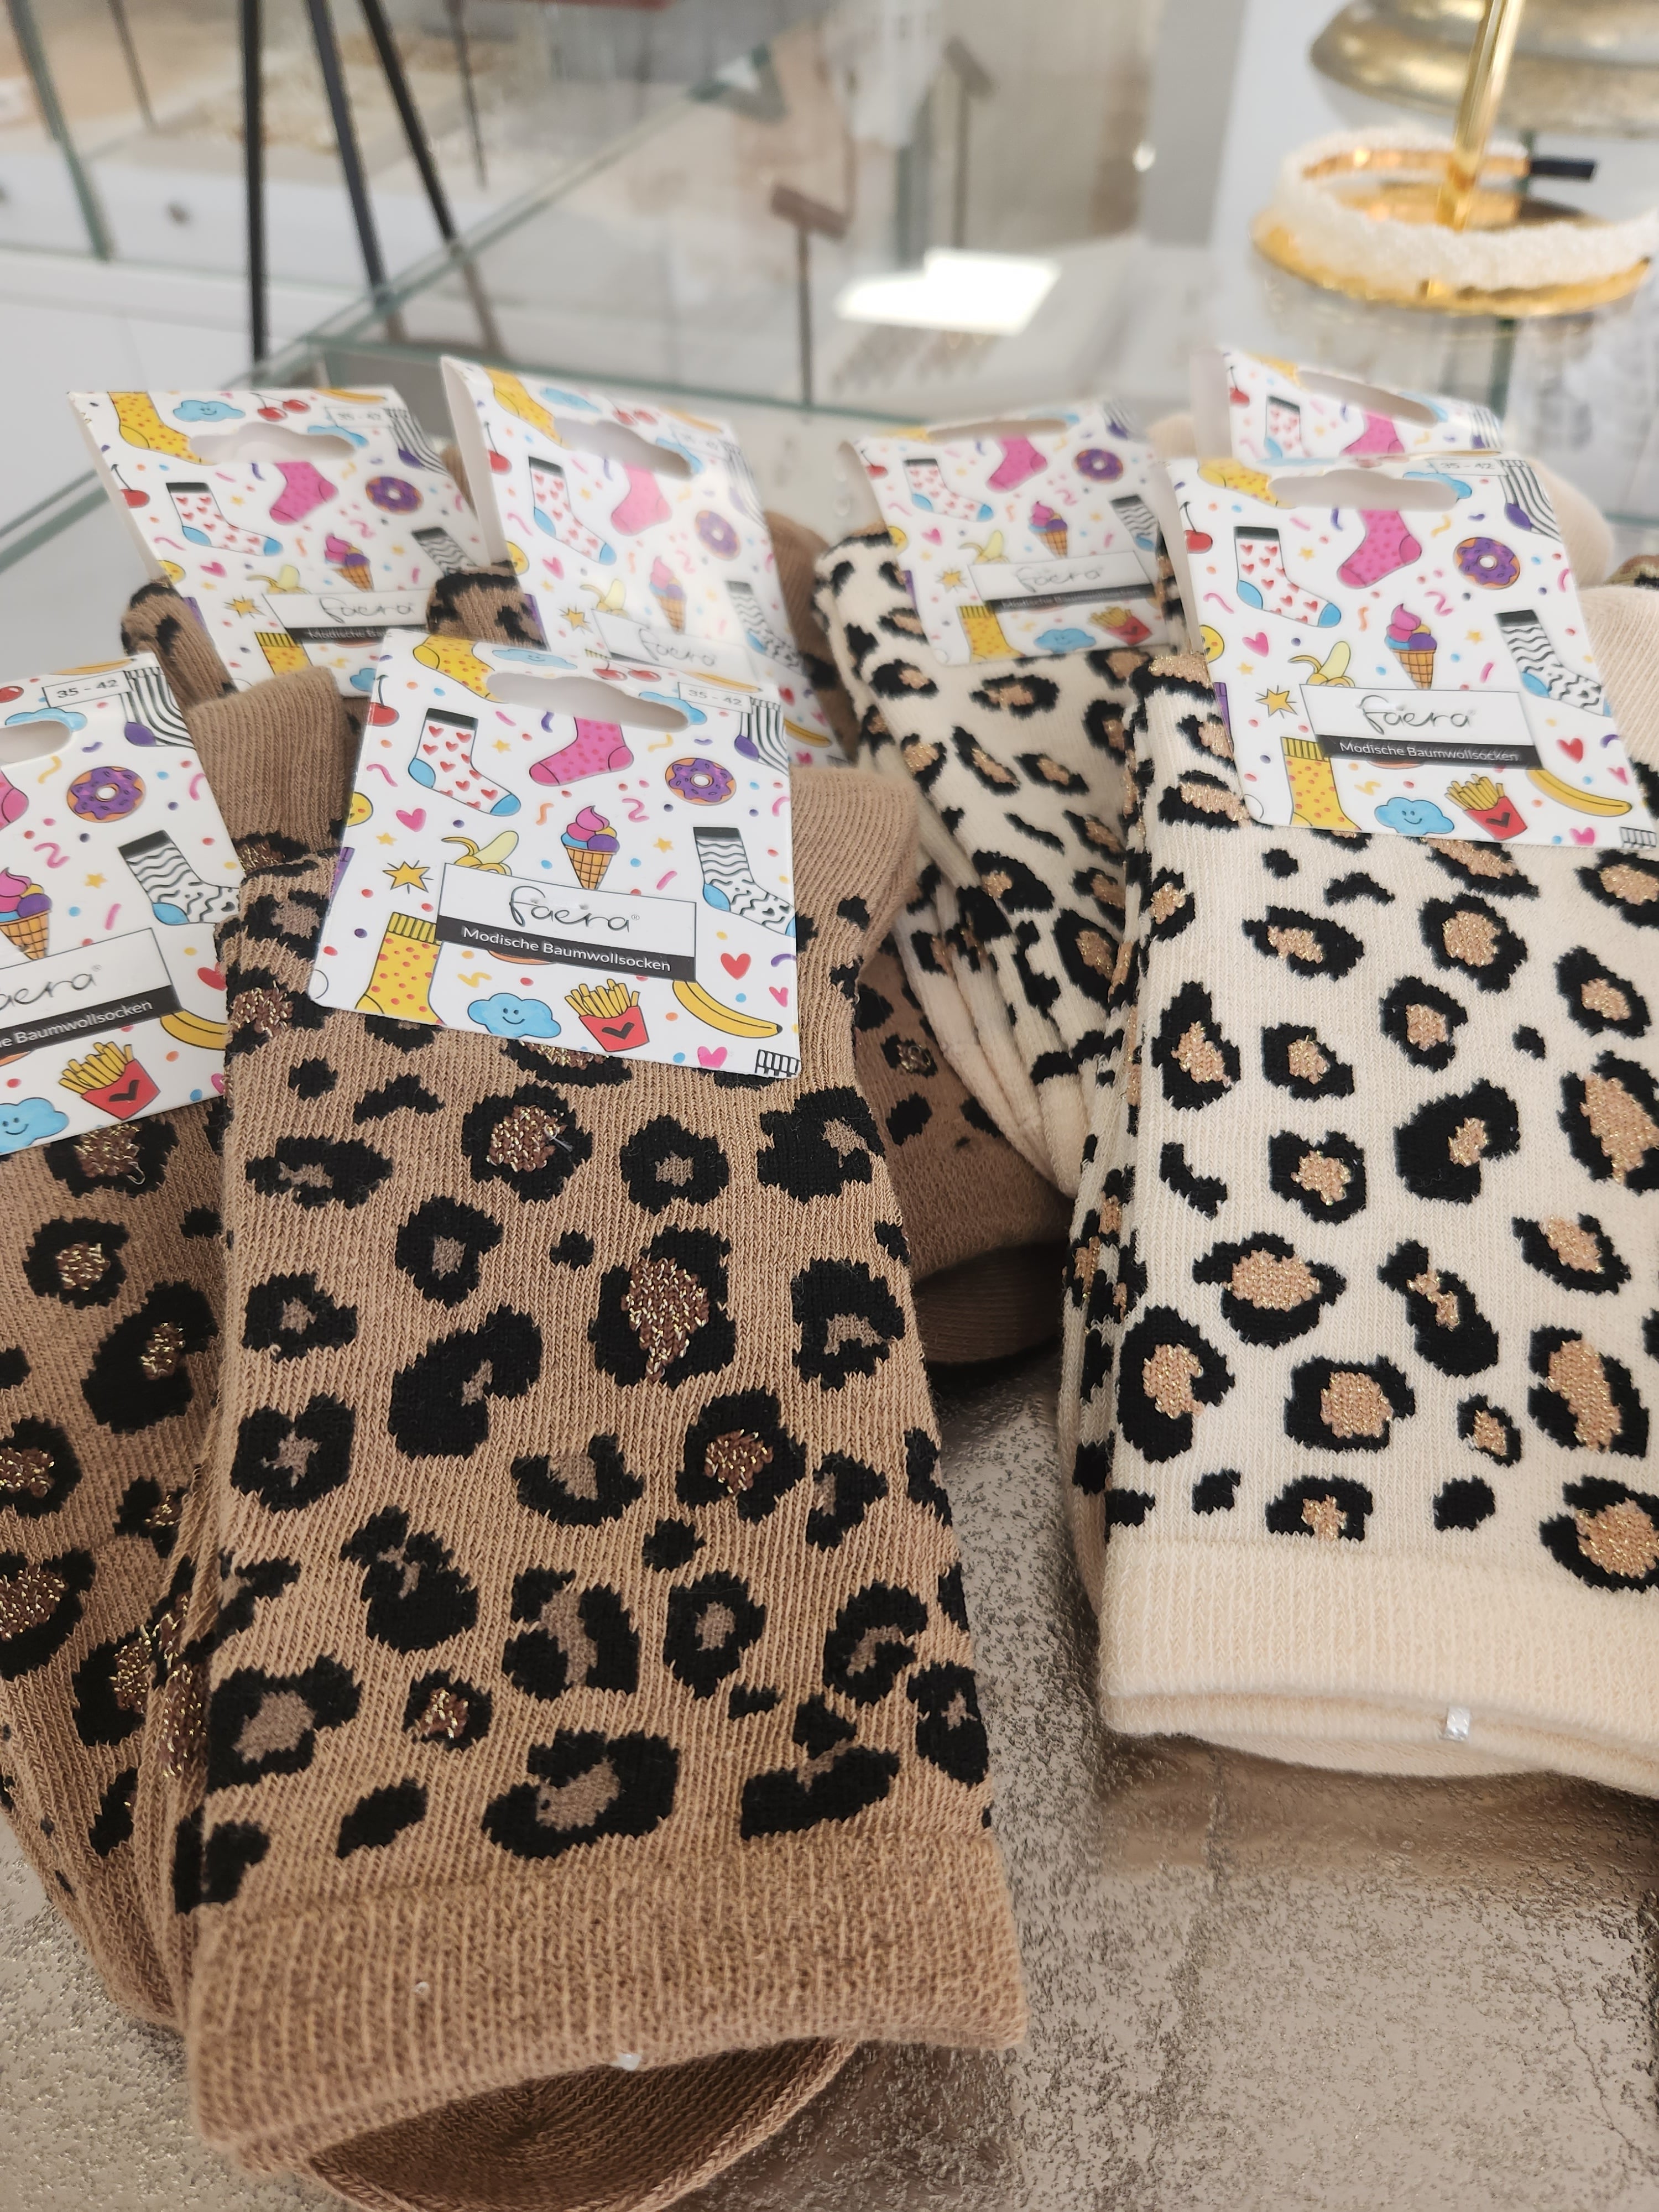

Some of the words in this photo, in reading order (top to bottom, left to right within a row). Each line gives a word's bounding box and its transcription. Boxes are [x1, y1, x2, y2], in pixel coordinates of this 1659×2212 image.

[56, 687, 80, 698] 35
[96, 679, 120, 689] 42
[688, 689, 708, 699] 35
[724, 696, 743, 706] 42
[1339, 742, 1405, 757] Modische
[1407, 747, 1519, 762] Baumwollsocken
[462, 926, 539, 952] Modische
[542, 941, 671, 972] Baumwollsocken
[14, 1000, 154, 1044] Baumwollsocken
